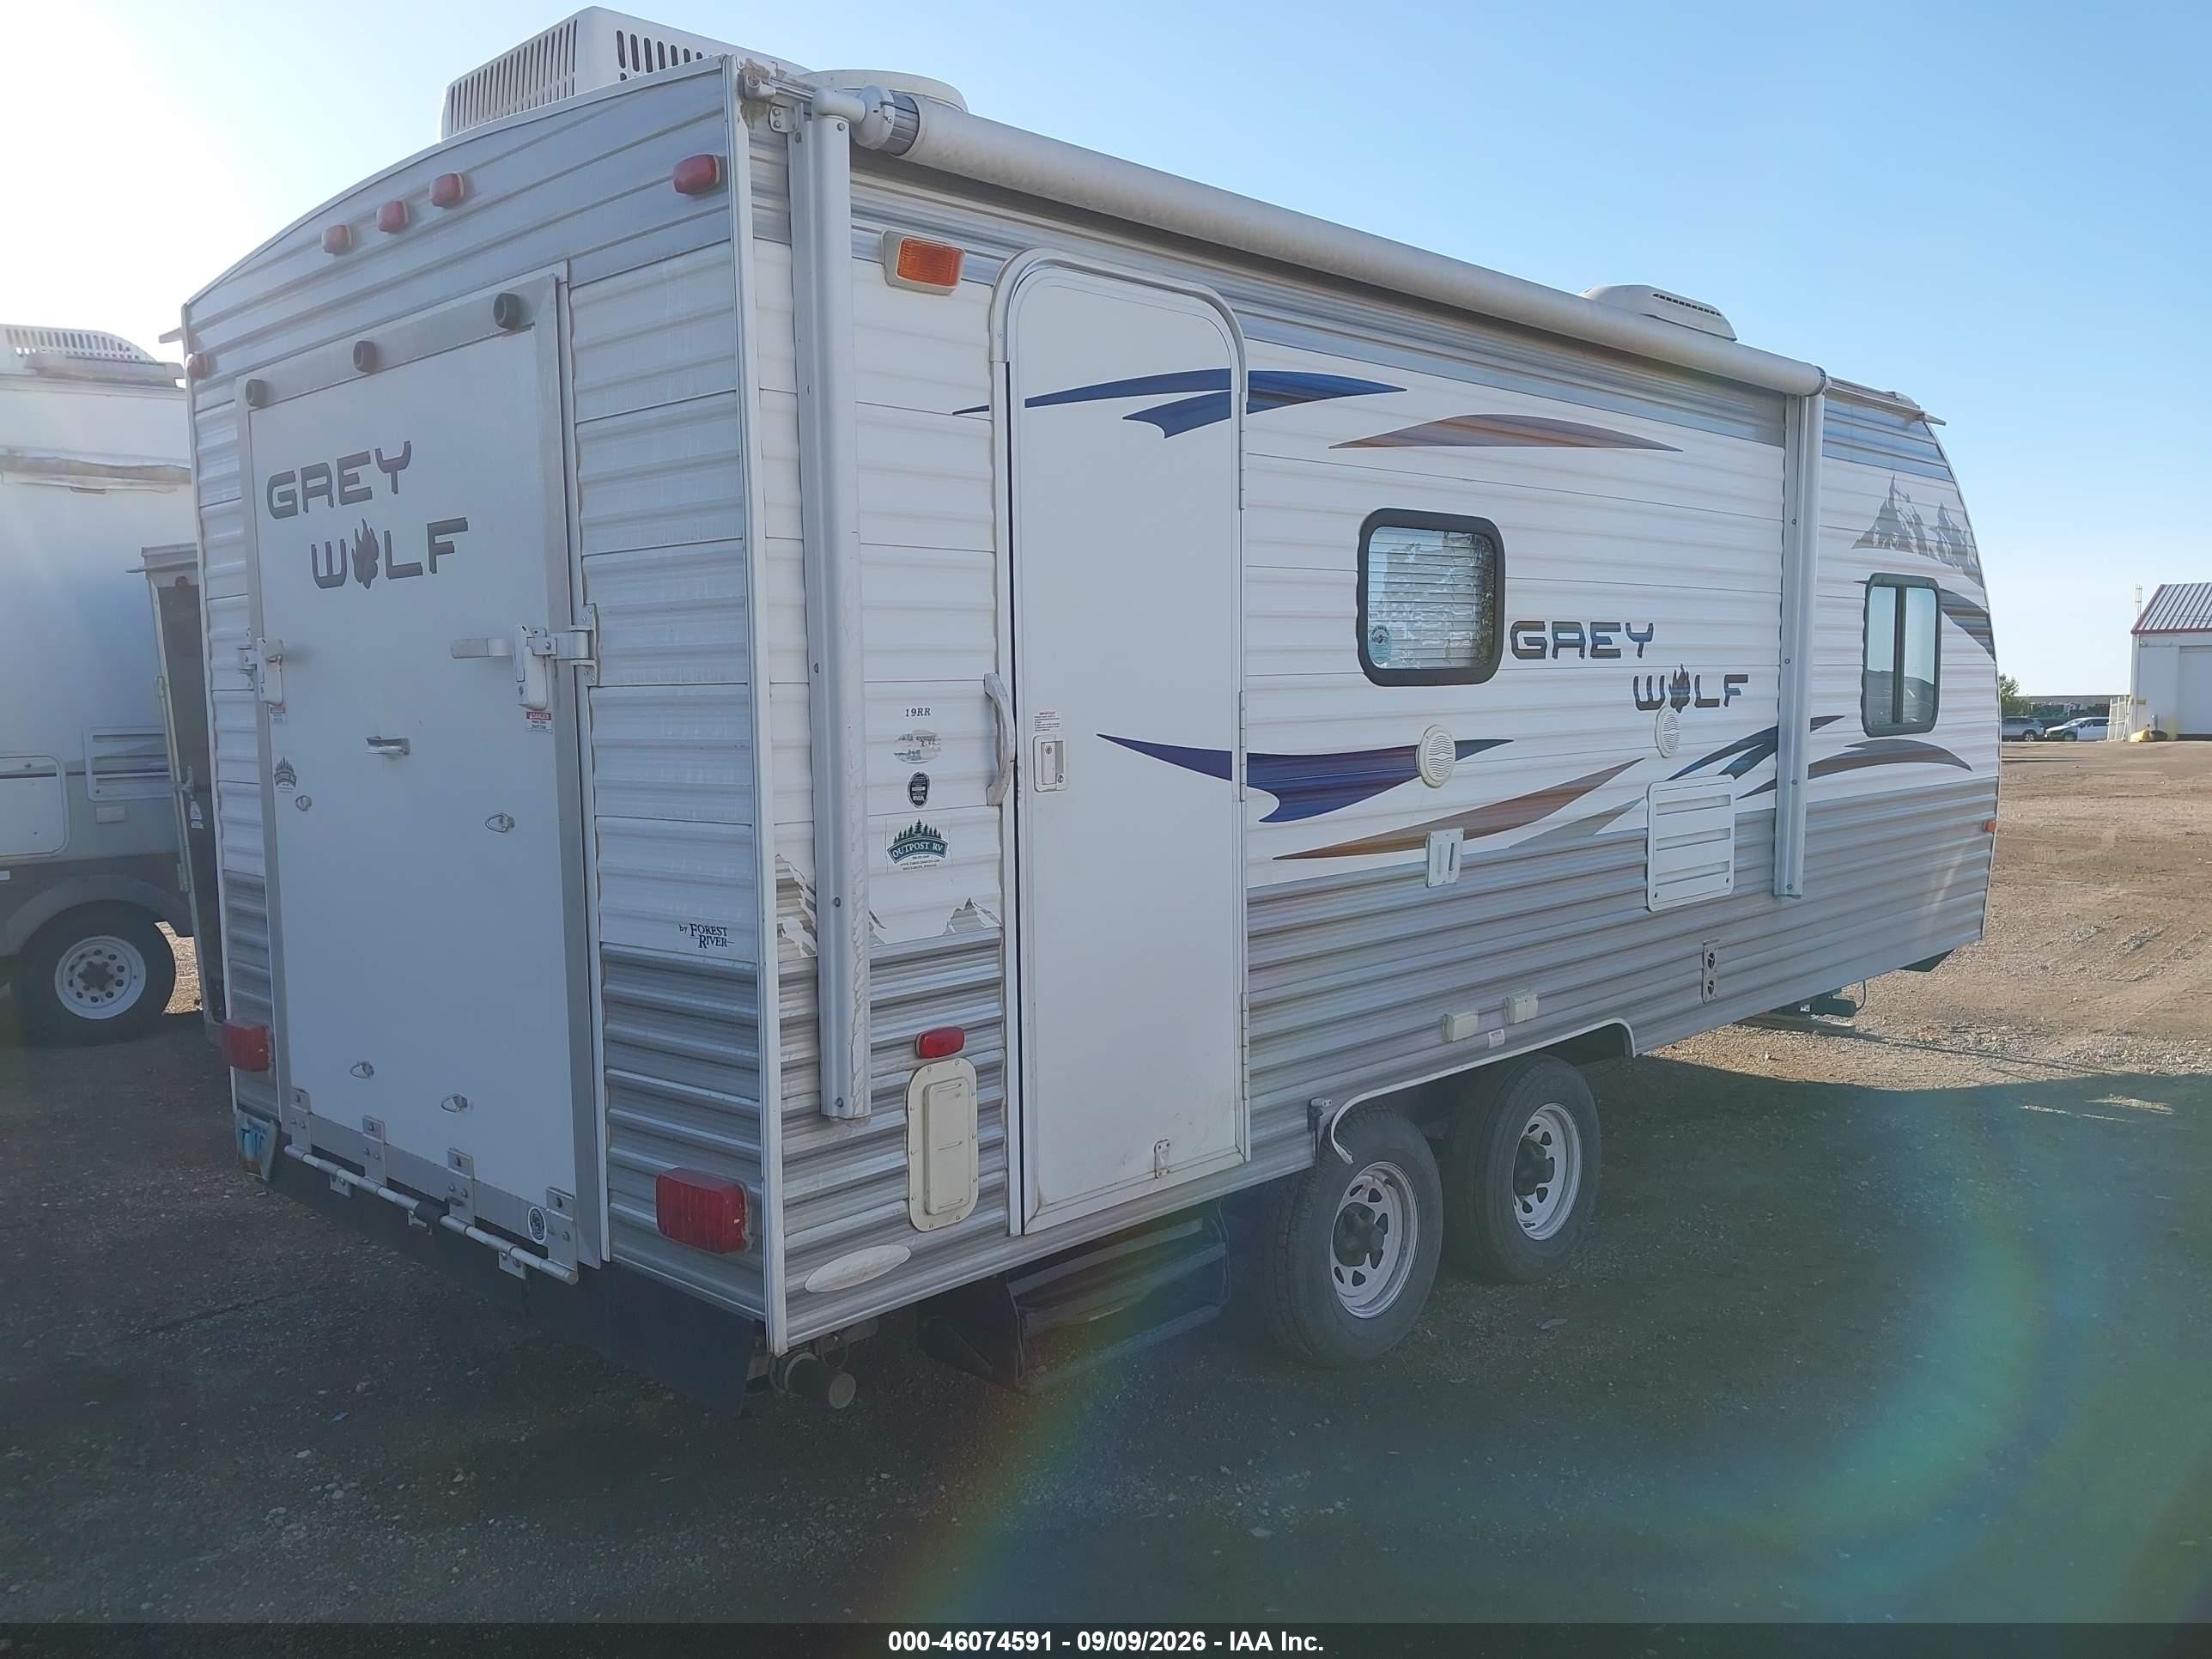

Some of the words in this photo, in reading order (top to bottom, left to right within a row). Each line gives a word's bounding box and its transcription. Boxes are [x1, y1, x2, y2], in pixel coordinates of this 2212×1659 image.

[267, 441, 412, 520] GREY
[1510, 620, 1655, 660] GREY
[905, 707, 932, 717] 19RR
[893, 842, 930, 858] OUTPOST
[933, 842, 944, 852] RV
[678, 923, 688, 934] by
[690, 923, 728, 938] FOREST
[698, 934, 728, 949] RIVER
